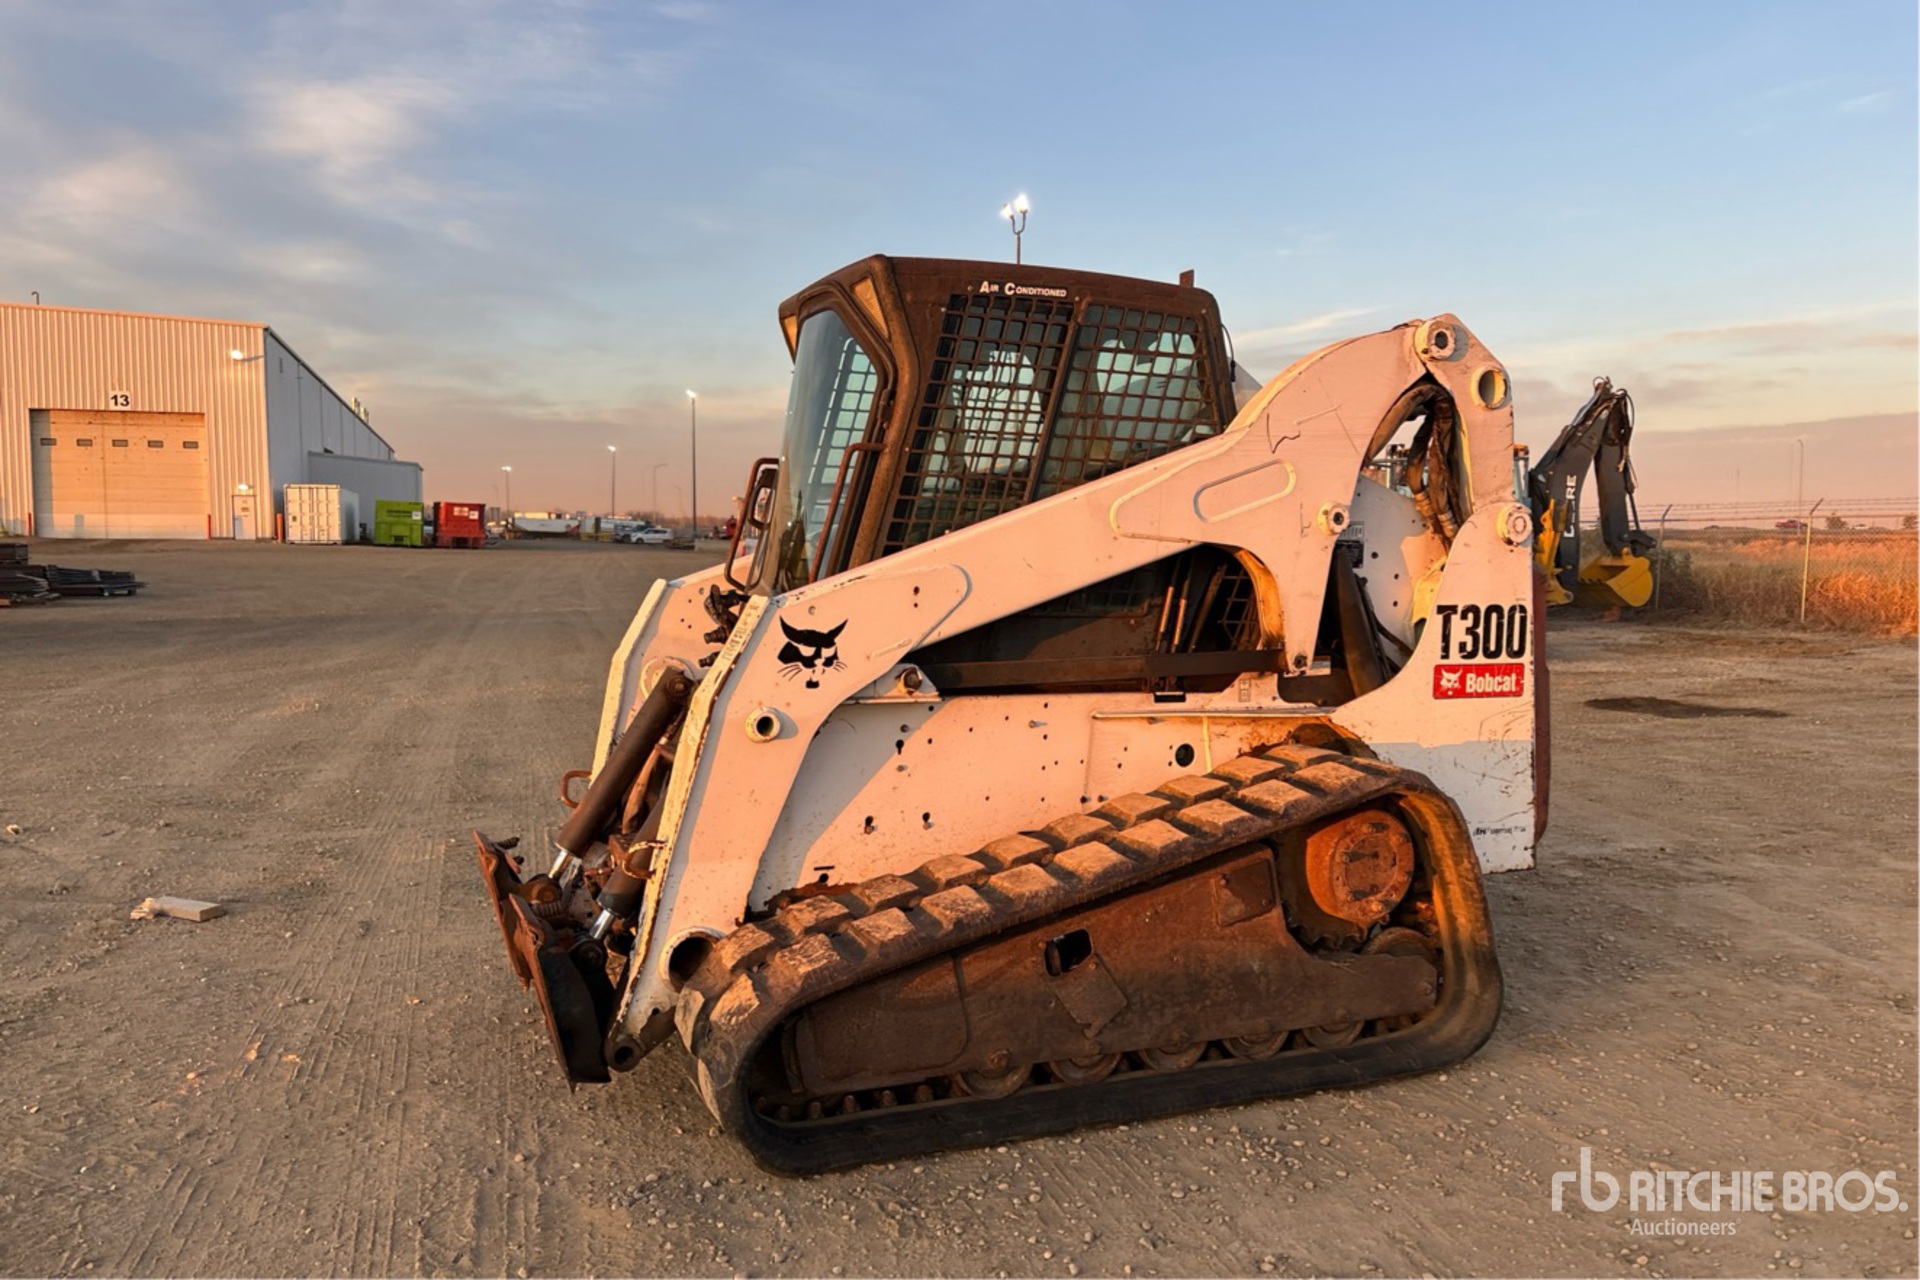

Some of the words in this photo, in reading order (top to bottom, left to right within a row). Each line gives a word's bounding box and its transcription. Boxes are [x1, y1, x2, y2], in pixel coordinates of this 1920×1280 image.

[110, 394, 130, 407] 13
[1563, 475, 1577, 538] DRE
[1436, 604, 1527, 660] T300
[1465, 673, 1517, 693] Bobcat
